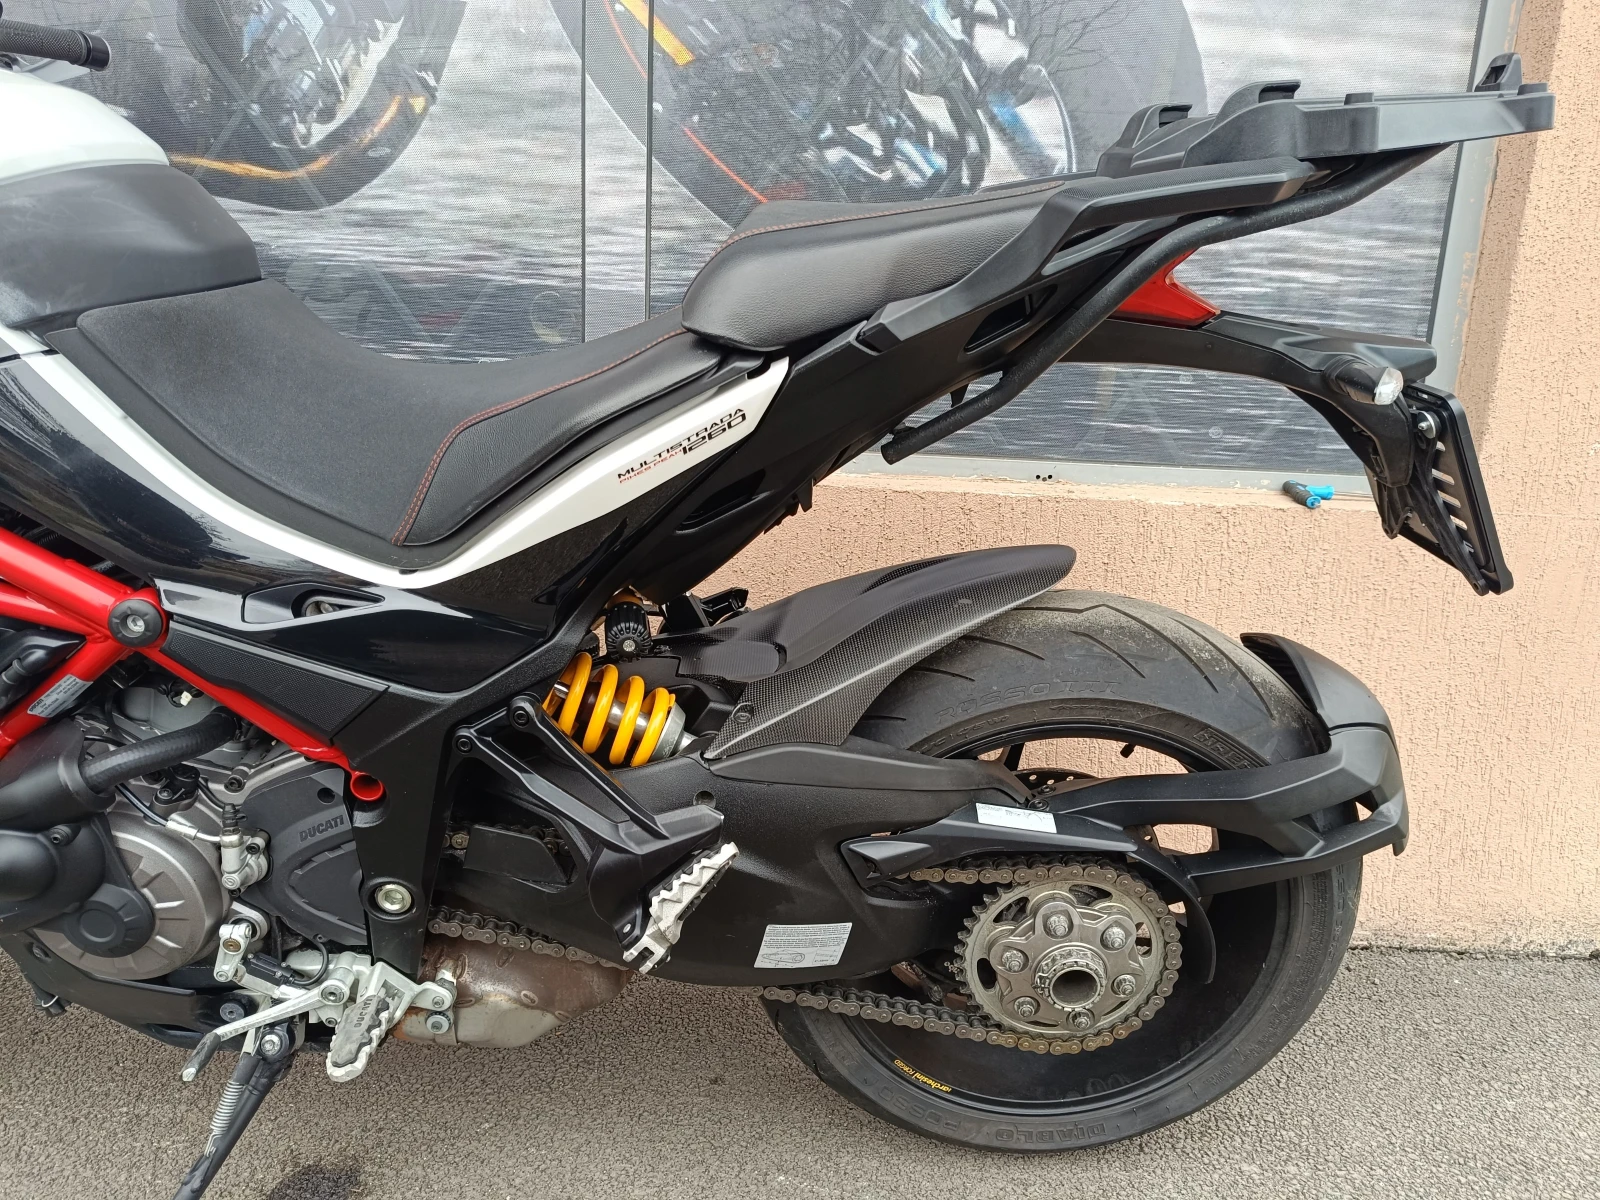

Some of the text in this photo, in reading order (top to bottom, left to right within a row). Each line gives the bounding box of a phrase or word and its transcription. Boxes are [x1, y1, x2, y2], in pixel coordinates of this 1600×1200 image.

[617, 408, 744, 479] MULTISTRADA
[683, 413, 747, 456] 1260
[934, 683, 1051, 724] ROSSO
[298, 814, 345, 842] DUCATI
[353, 998, 373, 1028] DUCATI
[912, 1072, 952, 1092] archesini
[878, 1086, 961, 1131] ROSSO
[995, 1122, 1107, 1143] DIABLO
